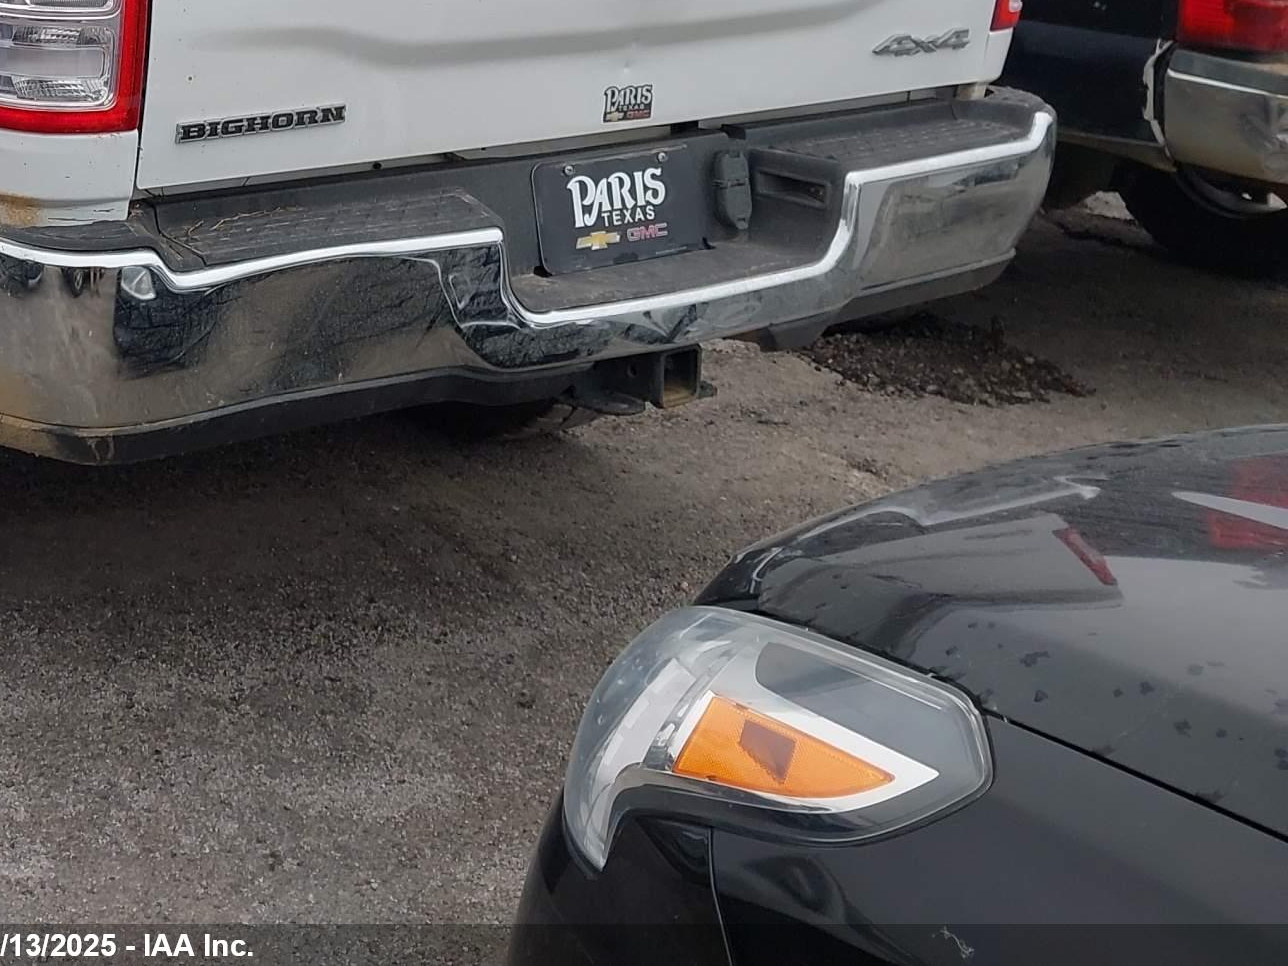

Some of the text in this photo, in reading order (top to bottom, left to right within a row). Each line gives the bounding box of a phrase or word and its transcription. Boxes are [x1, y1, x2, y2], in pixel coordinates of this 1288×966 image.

[604, 85, 652, 112] PARIS
[176, 104, 346, 144] BIGHORN
[566, 167, 666, 228] PARIS
[601, 205, 655, 227] TEXAS
[626, 222, 668, 242] GMC
